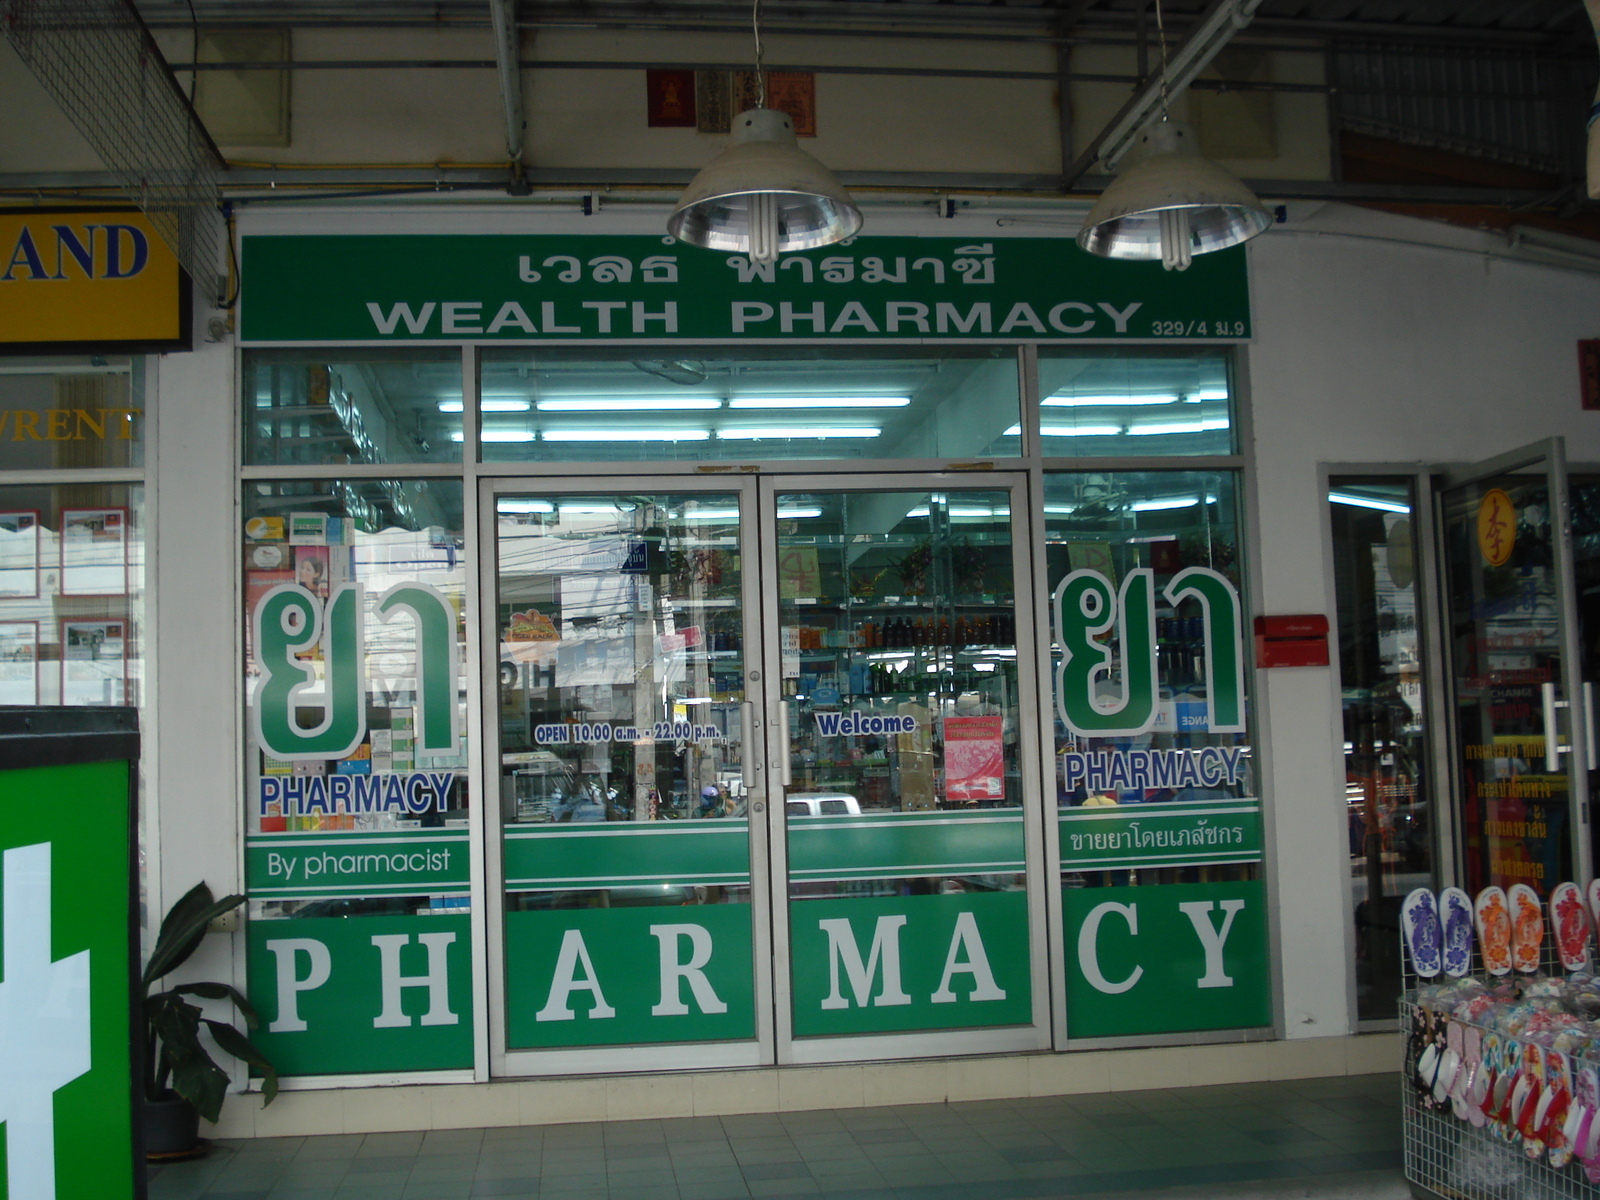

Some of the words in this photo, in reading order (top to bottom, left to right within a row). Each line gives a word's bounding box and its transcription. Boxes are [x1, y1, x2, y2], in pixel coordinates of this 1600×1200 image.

[1, 224, 149, 281] AND
[366, 301, 679, 335] WEALTH
[730, 300, 1144, 334] PHARMACY
[1151, 320, 1208, 336] 329/4
[1053, 566, 1246, 738] ยา
[253, 581, 460, 762] ยา
[535, 725, 570, 744] OPEN
[573, 723, 612, 744] 10.00
[614, 726, 642, 742] a.m.
[654, 721, 692, 742] 22.00
[693, 724, 721, 744] p.m.
[814, 711, 919, 738] Welcome
[1064, 746, 1242, 793] PHARMACY
[259, 772, 454, 817] PHARMACY
[1069, 819, 1243, 851] ขายยาโดยเภสัชกร
[267, 852, 297, 880] By
[304, 848, 451, 879] pharmacist
